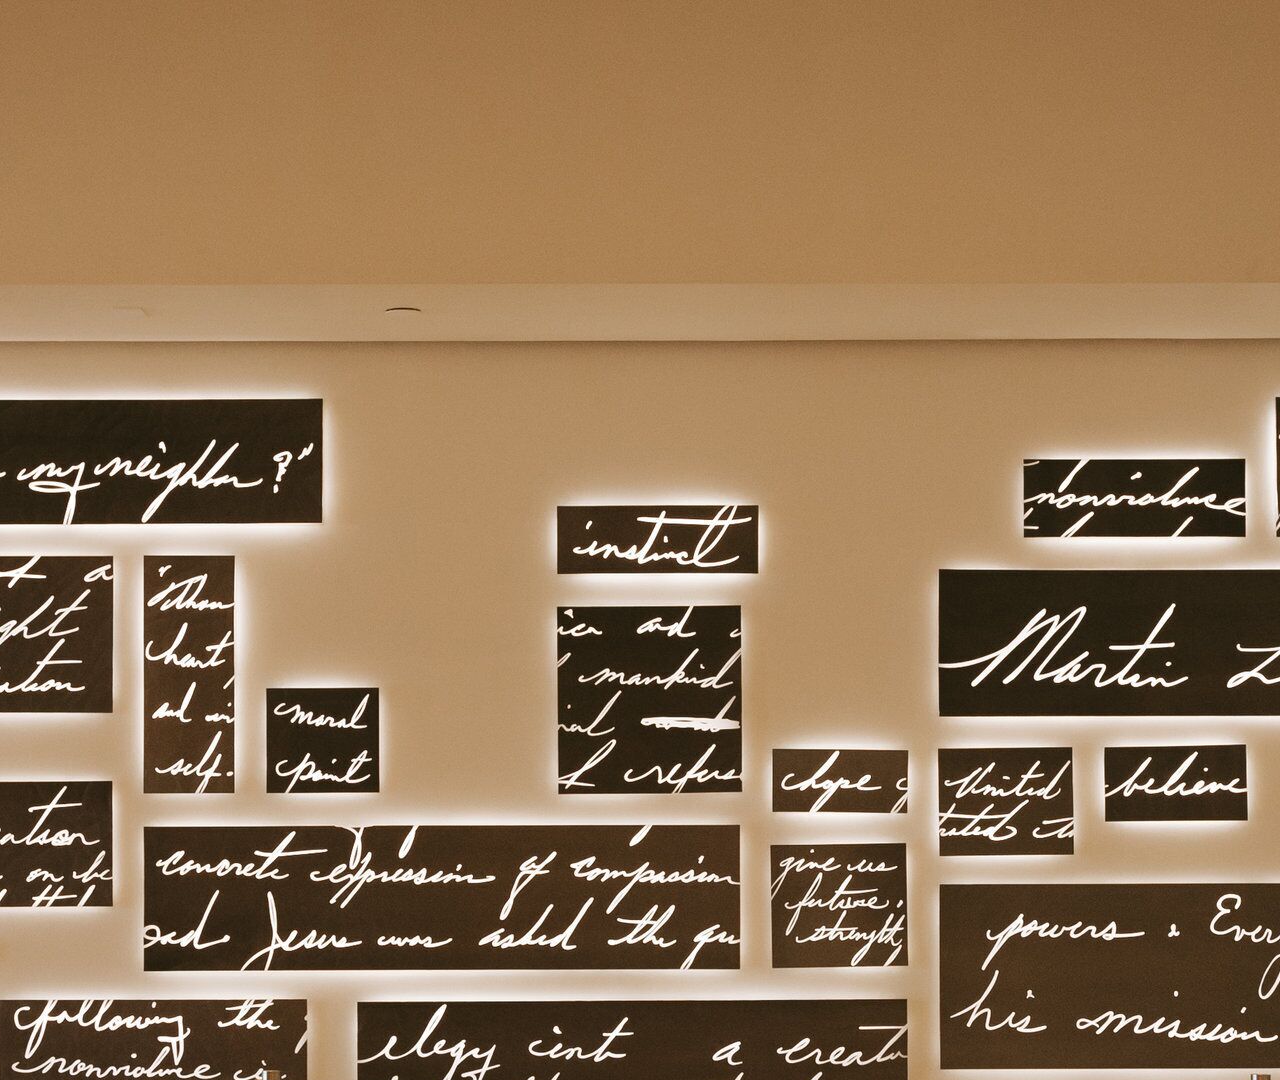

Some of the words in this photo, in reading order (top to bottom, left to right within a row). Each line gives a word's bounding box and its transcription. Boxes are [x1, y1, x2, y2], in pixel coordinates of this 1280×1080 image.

[16, 461, 100, 525] my
[572, 504, 752, 568] instinct
[635, 603, 697, 638] and
[940, 602, 1189, 689] Martin
[577, 647, 741, 690] mankind
[151, 681, 197, 724] and
[273, 692, 371, 730] moral
[780, 750, 883, 813] hope
[945, 760, 1071, 800] United
[1106, 750, 1247, 796] believe
[155, 830, 329, 881] concrete
[499, 851, 557, 920] of
[240, 890, 363, 971] Jesus
[376, 933, 454, 948] was
[478, 897, 595, 951] asked
[607, 904, 677, 948] the
[13, 1000, 191, 1064] following
[217, 1000, 280, 1031] the
[949, 969, 1048, 1033] his
[1075, 989, 1279, 1044] mission
[11, 1046, 222, 1079] nonviolence
[712, 1040, 743, 1066] a
